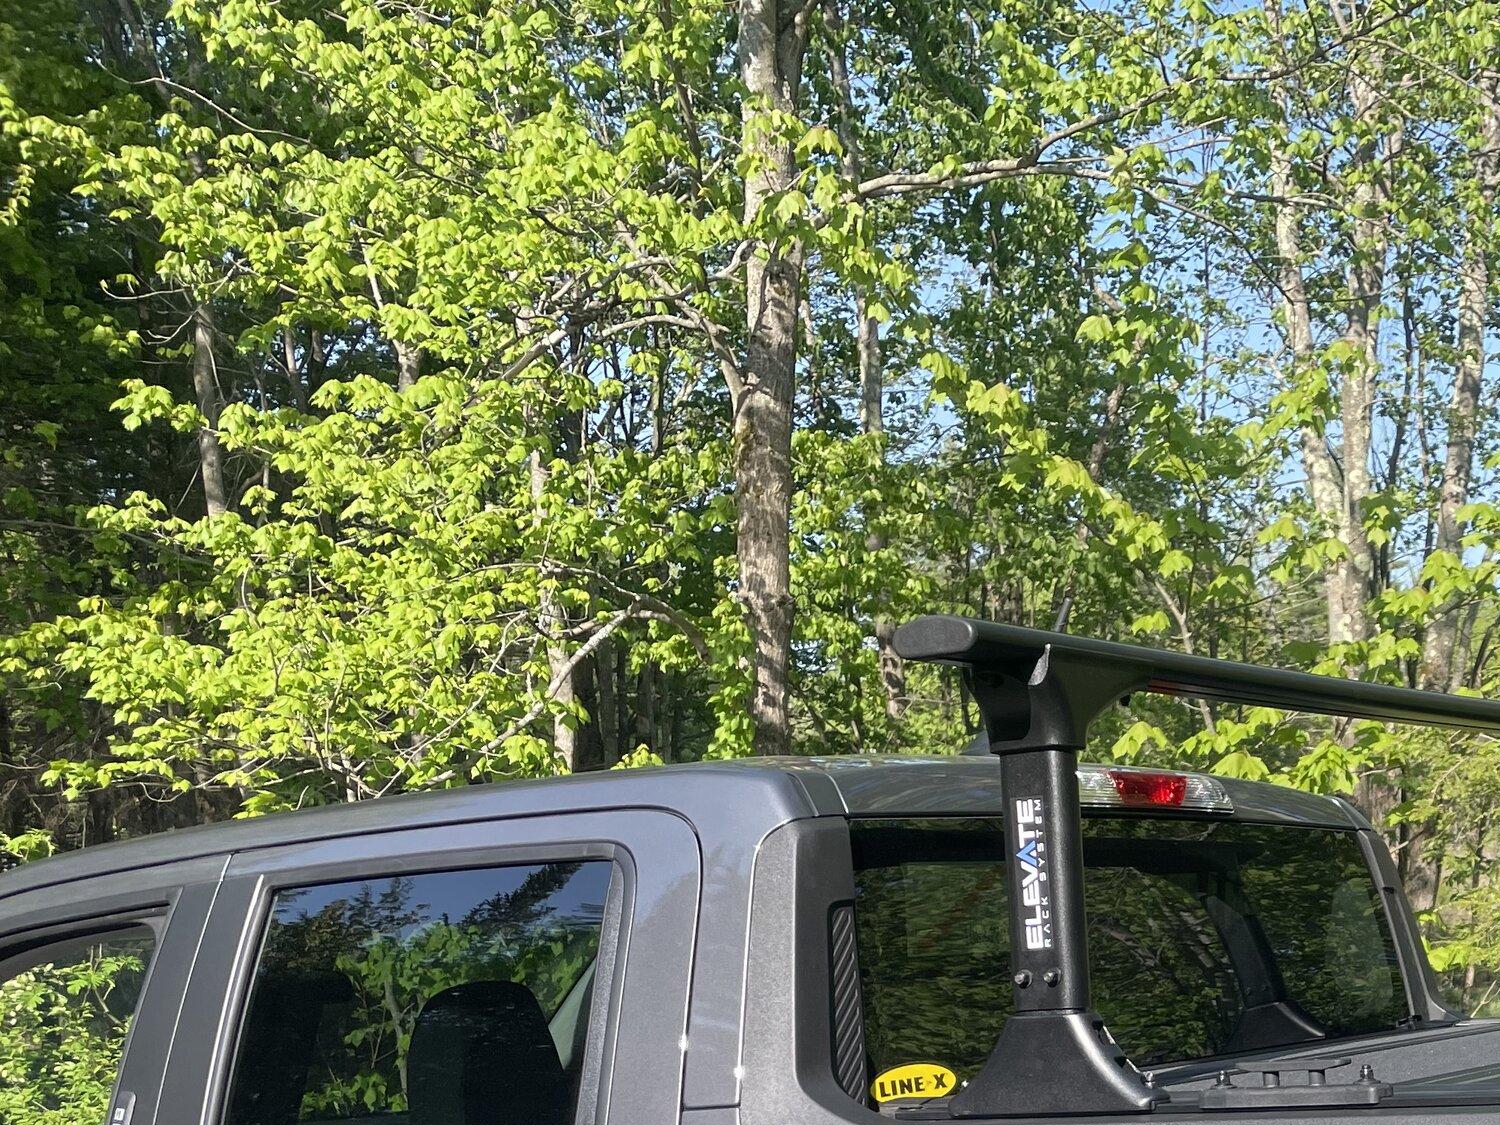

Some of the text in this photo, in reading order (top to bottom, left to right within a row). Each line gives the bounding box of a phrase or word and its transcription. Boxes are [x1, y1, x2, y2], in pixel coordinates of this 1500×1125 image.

[1016, 798, 1043, 949] ELEVATE
[1034, 800, 1052, 947] RACK SYSTEM
